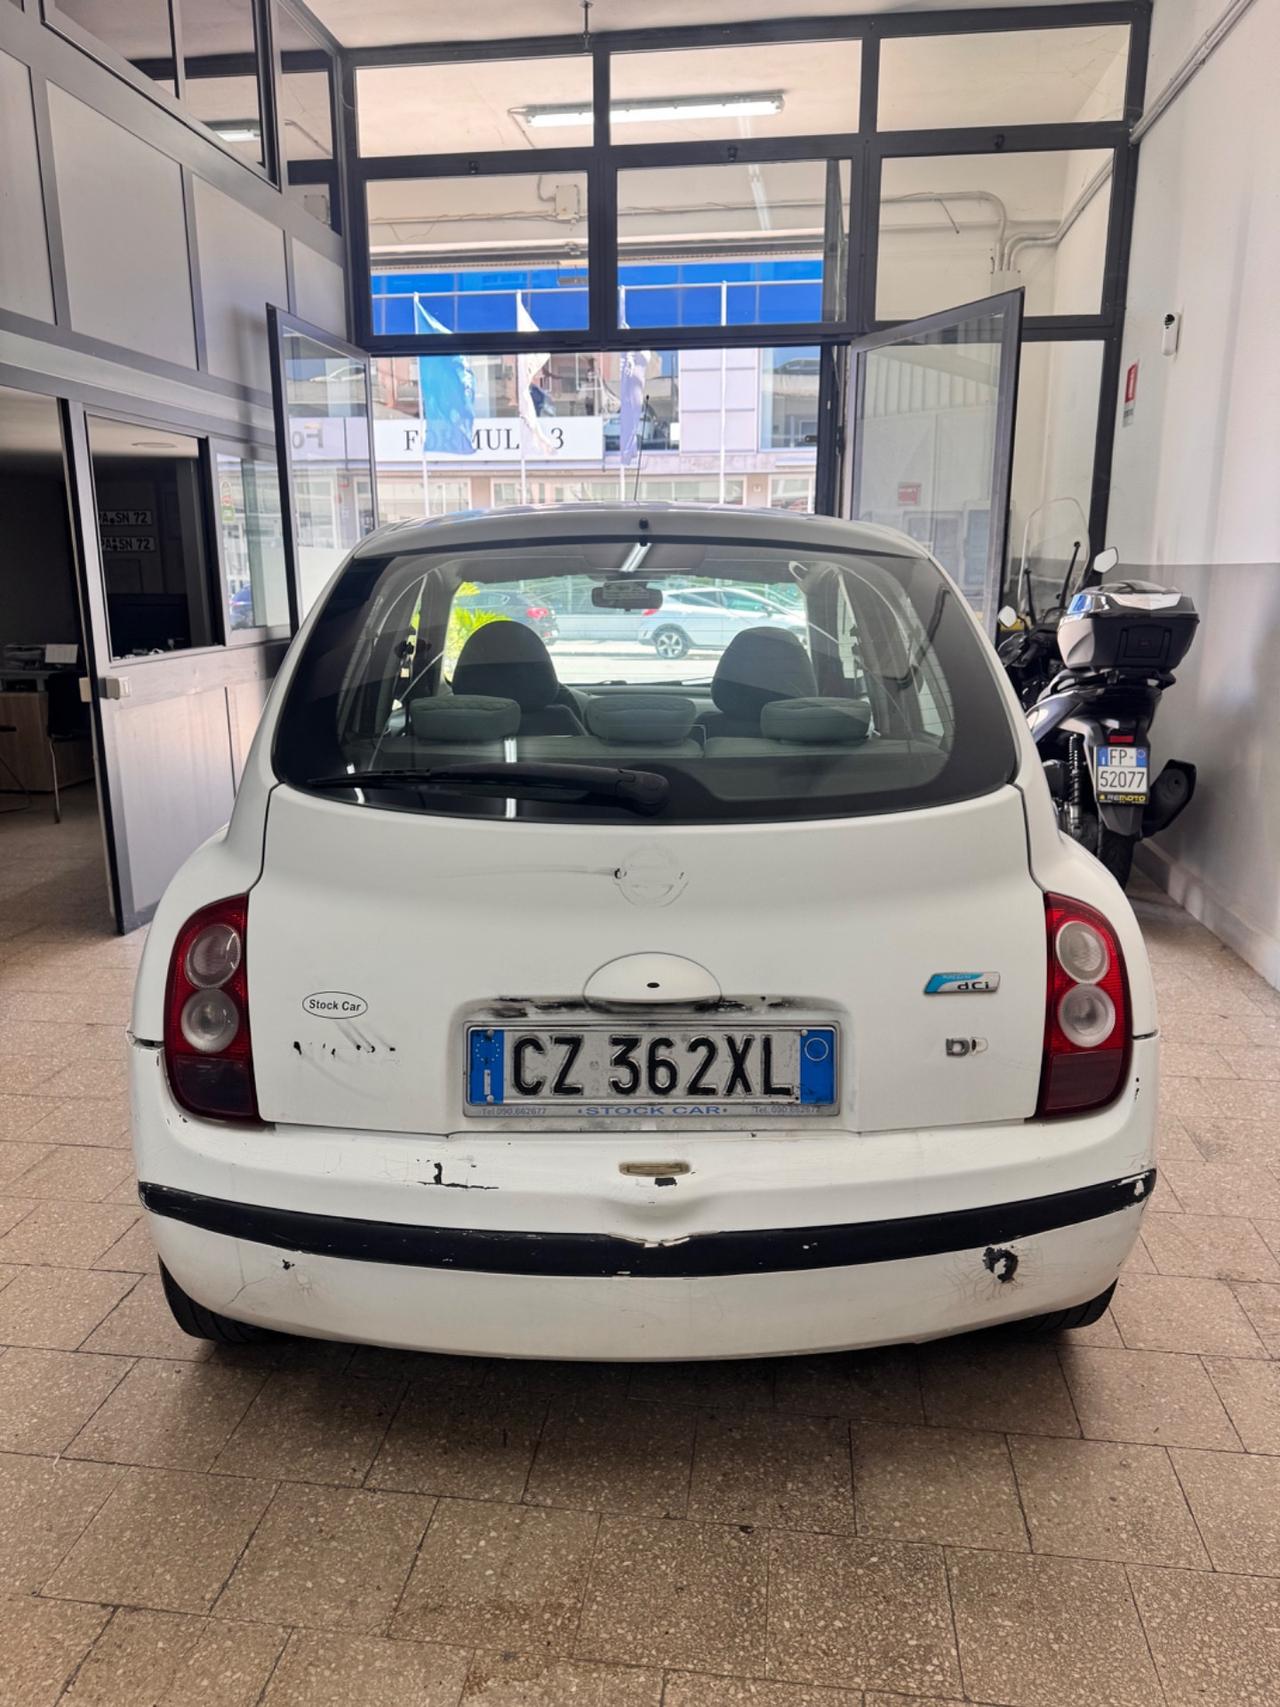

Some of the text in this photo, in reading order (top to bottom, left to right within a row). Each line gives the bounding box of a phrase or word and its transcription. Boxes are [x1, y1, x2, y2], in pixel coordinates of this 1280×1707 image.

[551, 427, 565, 450] 3
[1110, 749, 1128, 765] FP
[1100, 770, 1145, 788] 52077
[308, 999, 361, 1011] Stock Car
[512, 1035, 584, 1096] CZ
[609, 1035, 795, 1096] 362XL
[586, 1106, 721, 1116] STOCK CAR
